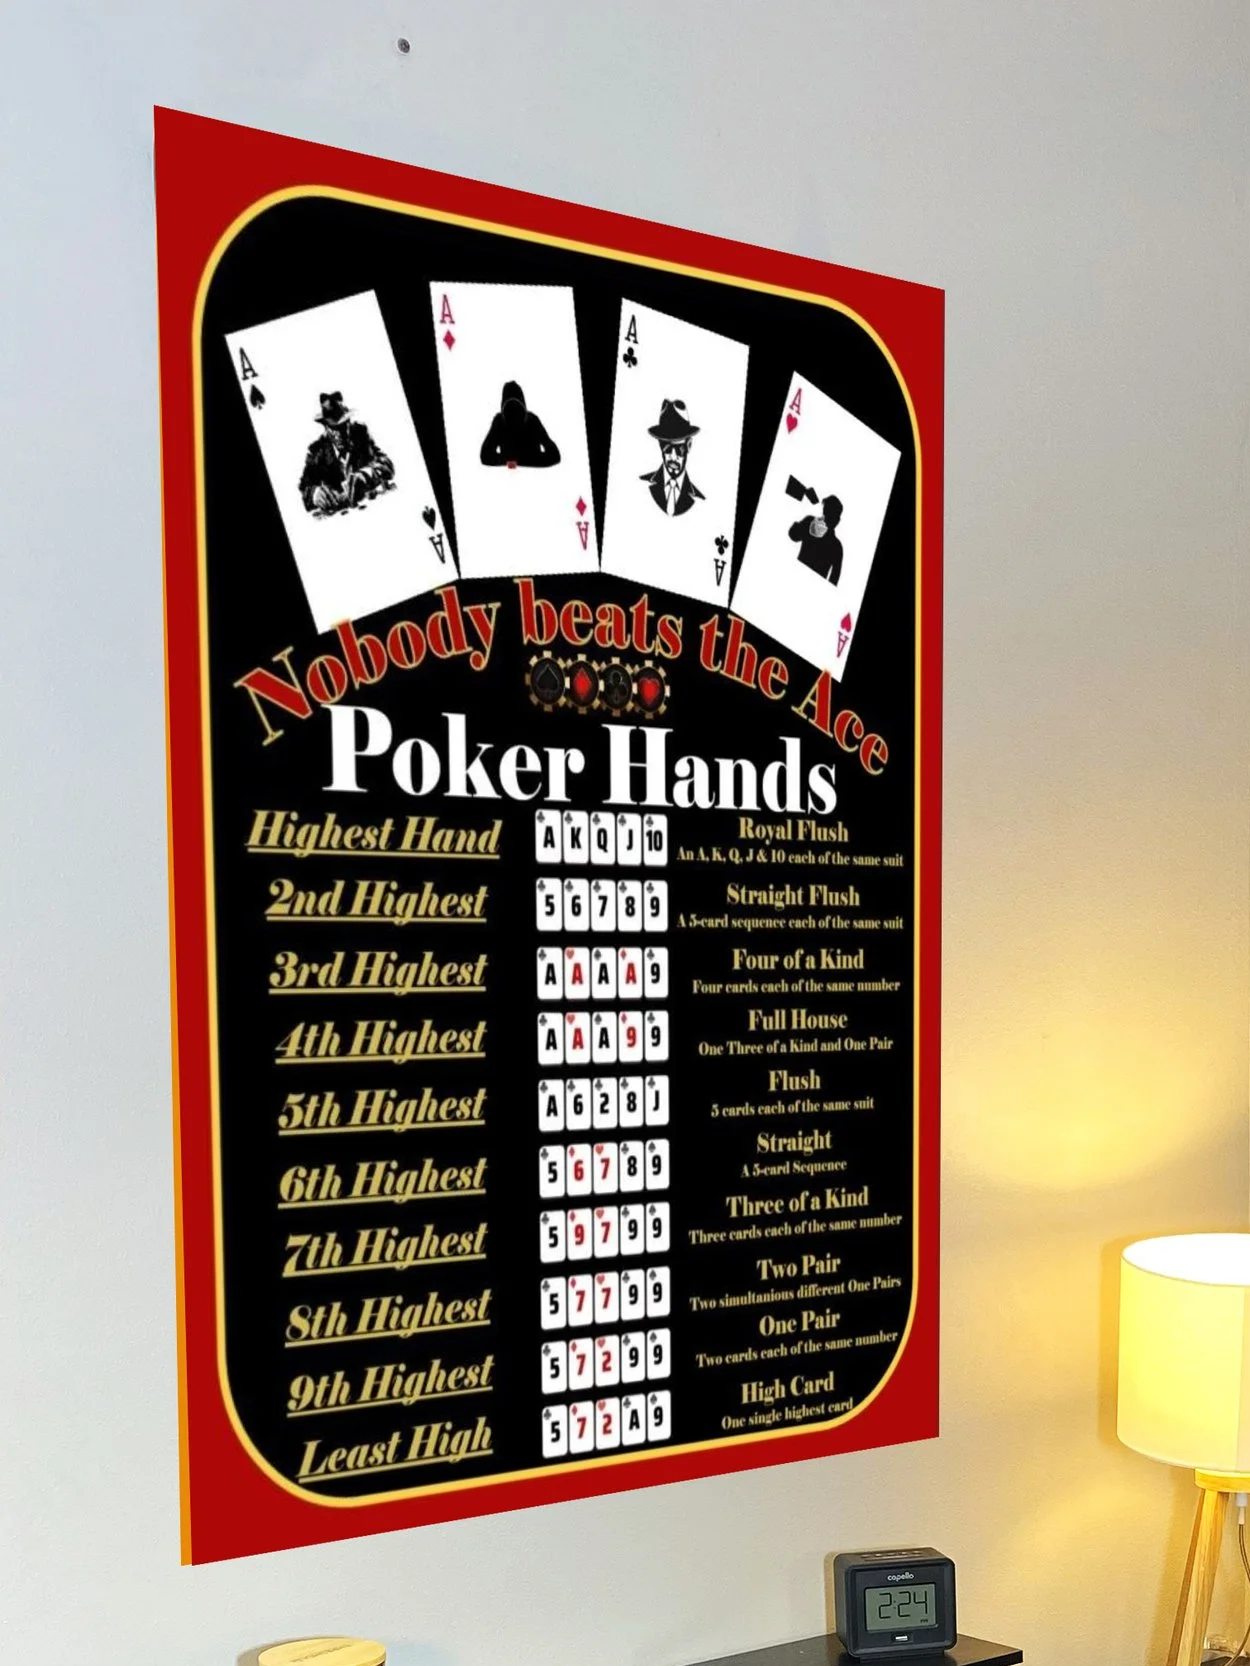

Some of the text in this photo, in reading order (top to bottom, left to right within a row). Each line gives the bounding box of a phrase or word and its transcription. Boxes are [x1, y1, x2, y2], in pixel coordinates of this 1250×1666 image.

[440, 295, 454, 324] A
[625, 315, 638, 344] A
[235, 348, 258, 382] A
[787, 386, 801, 415] A
[233, 578, 889, 775] Nobody beats the Ace
[321, 704, 837, 815] Poker Hands
[245, 809, 503, 858] Highest Hand
[544, 826, 662, 852] A K Q J 10
[739, 817, 848, 845] Royal Flush
[677, 847, 903, 866] An A, K, Q, J & 10 each of the same suit
[265, 877, 489, 927] 2nd Highest
[546, 895, 659, 917] 5 6 7 8 9
[727, 884, 860, 909] Straight Flush
[677, 914, 903, 932] A 5-card sequence each of the same suit
[268, 951, 489, 996] 3rd Highest
[545, 963, 660, 985] A A A A 9
[733, 949, 864, 970] Four of a Kind
[693, 978, 900, 993] Four cards each of the same number
[749, 1009, 847, 1031] Full House
[275, 1020, 487, 1065] 4th Highest
[546, 1026, 660, 1050] A A A 9 9
[699, 1037, 893, 1055] One Three of a Kind and One Pair
[769, 1069, 820, 1091] Flush
[279, 1088, 487, 1132] 5th Highest
[757, 1129, 831, 1155] Straight
[279, 1157, 488, 1203] 6th Highest
[548, 1155, 661, 1183] 5 6 7 8 9
[726, 1186, 868, 1217] Three of a Kind
[689, 1213, 902, 1244] Three cards each of the same number
[283, 1223, 488, 1276] 7th Highest
[757, 1253, 840, 1280] Two Pair
[550, 1282, 662, 1314] 5 7 7 9 9
[690, 1276, 901, 1311] Two simultanious different One Pairs
[285, 1289, 492, 1342] 8th Highest
[759, 1308, 840, 1336] One Pair
[696, 1330, 898, 1367] Two cards each of the same number
[287, 1355, 494, 1412] 9th Highest
[742, 1371, 834, 1405] High Card
[551, 1406, 663, 1442] 5 7 2 A 9
[722, 1397, 853, 1429] One single highest card
[296, 1417, 494, 1481] Least High
